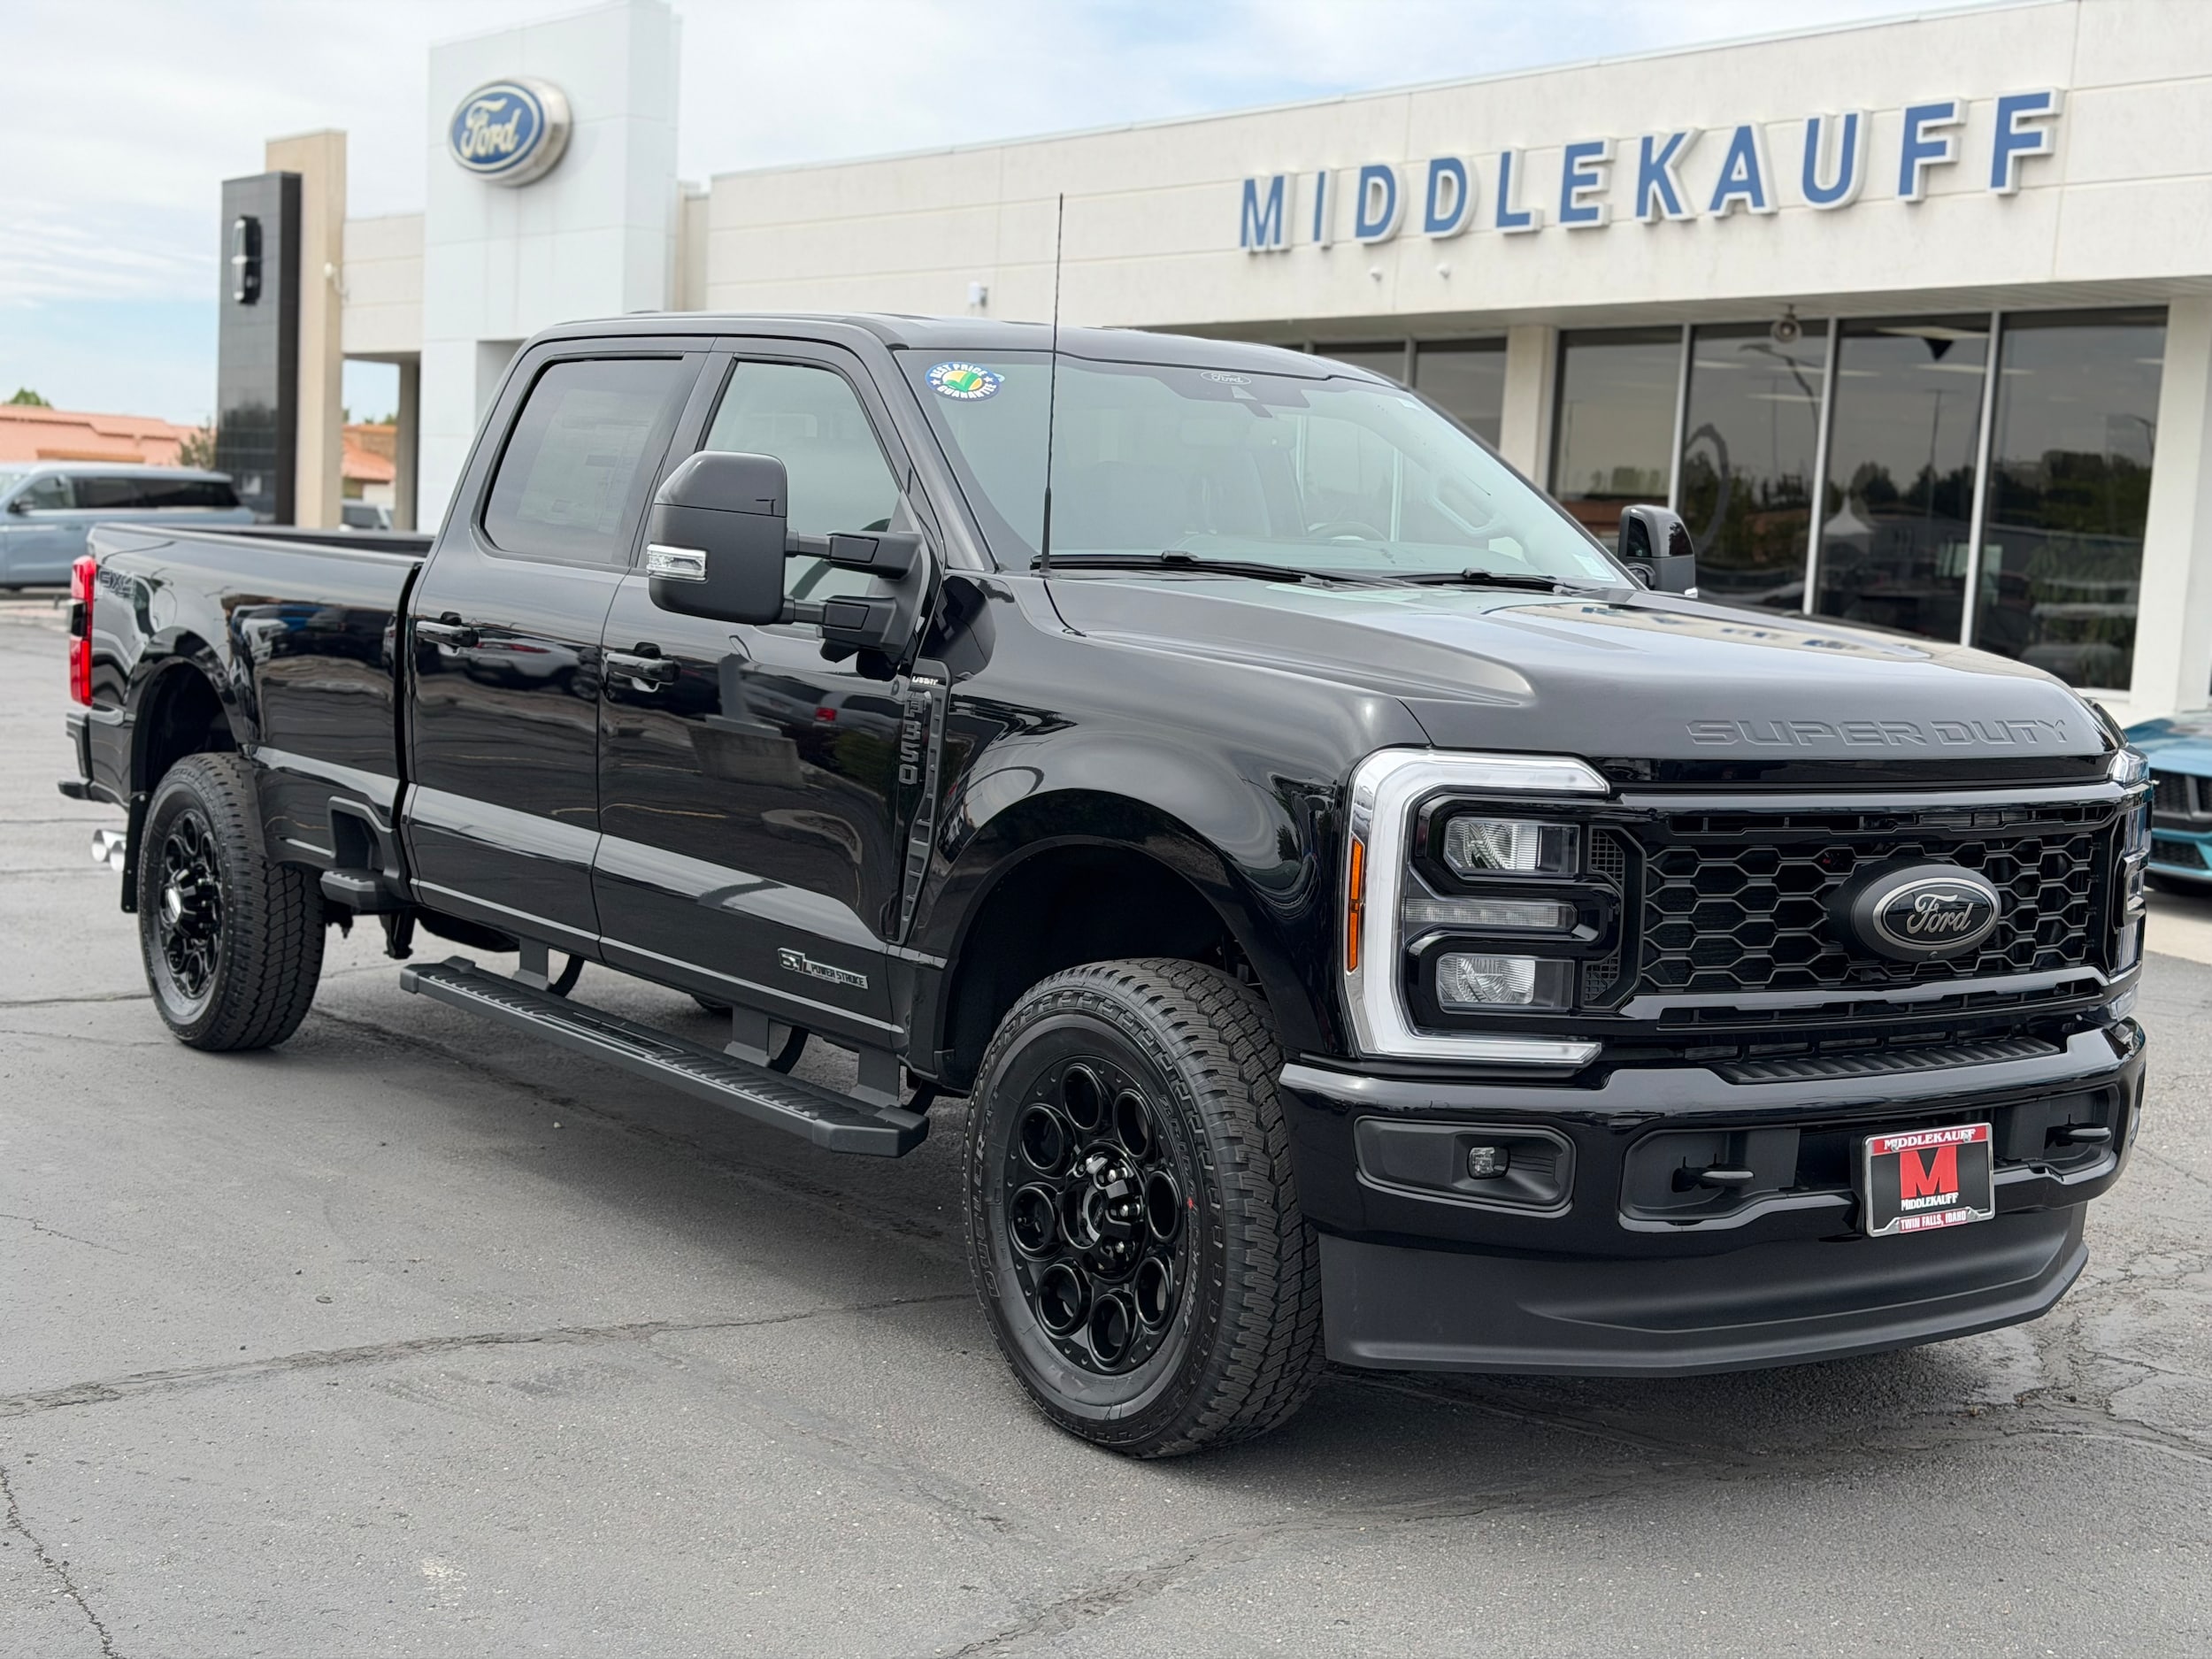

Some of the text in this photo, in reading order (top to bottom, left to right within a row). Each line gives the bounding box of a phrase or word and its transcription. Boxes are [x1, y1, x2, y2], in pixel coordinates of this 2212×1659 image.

[459, 97, 522, 158] Ford
[1240, 89, 2058, 252] MIDDLEKAUFF
[952, 363, 988, 377] PRICE
[1686, 718, 2068, 748] SUPER DUTY
[1906, 893, 1975, 934] Ford
[1884, 1129, 1976, 1150] MIDDLEKAUFF
[1900, 1145, 1959, 1199] M
[1901, 1193, 1959, 1211] MIDDLEKAUFF
[1901, 1216, 1921, 1231] TWIN
[1945, 1210, 1967, 1224] IDAHO
